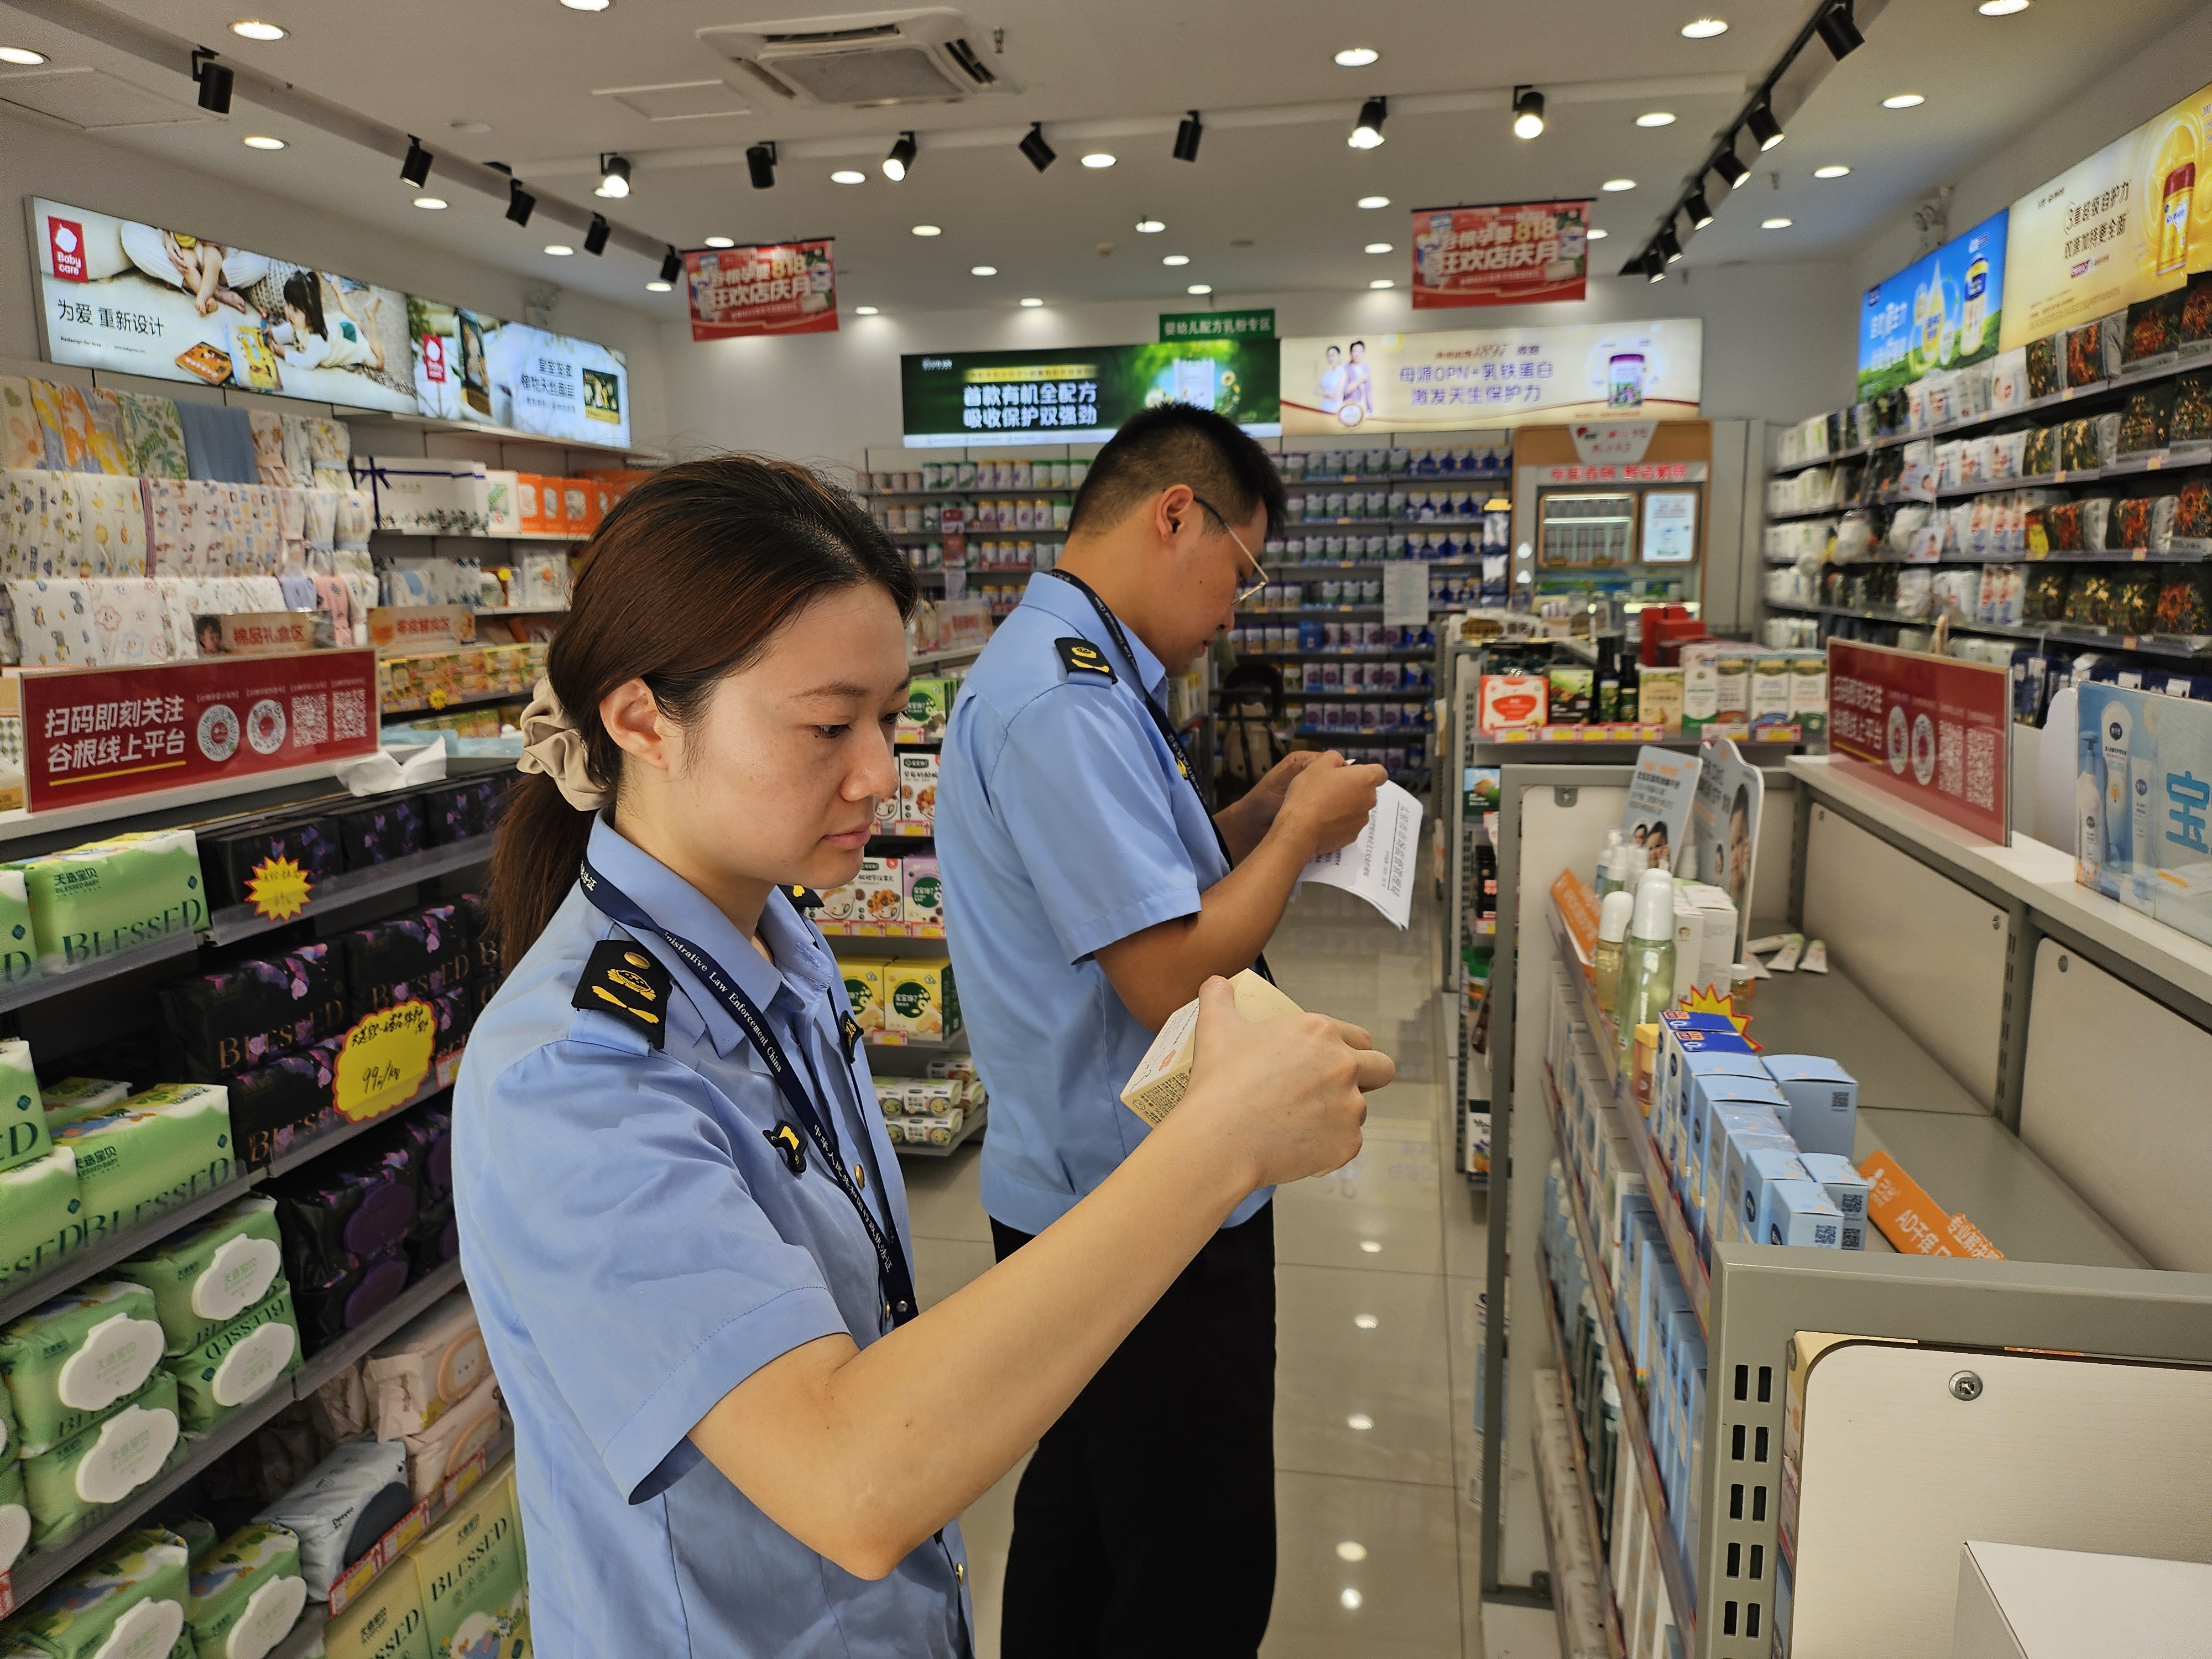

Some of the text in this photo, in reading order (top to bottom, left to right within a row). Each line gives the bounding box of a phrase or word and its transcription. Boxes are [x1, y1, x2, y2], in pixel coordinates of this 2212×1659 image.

[1515, 217, 1557, 241] 818
[58, 252, 81, 269] Baby
[59, 263, 80, 276] care
[772, 255, 807, 278] 818
[1441, 242, 1559, 275] 狂欢店庆月
[713, 276, 811, 311] 狂欢店庆月
[58, 299, 164, 338] 为爱 重新设计
[1164, 317, 1271, 336] 婴幼儿配方乳粉专区
[1400, 360, 1554, 384] 母源OPN+乳铁蛋白
[964, 382, 1097, 406] 首款有机全配方
[1411, 384, 1541, 406] 激发天生保护力
[963, 404, 1097, 428] 吸收保护双强劲
[1551, 464, 1687, 482] 中国首创 鲜活奶粉
[45, 696, 185, 739] 扫码即刻关注
[47, 729, 186, 773] 谷根线上平台
[54, 867, 98, 886] 天选宝贝
[62, 899, 201, 965] BLESSED
[709, 971, 728, 994] Law
[728, 992, 769, 1047] Enforcement
[766, 1045, 782, 1073] China
[82, 1157, 229, 1248] BLESSED
[814, 1124, 893, 1273] 中华人民共和国行政执法证
[431, 1517, 507, 1601] BLESSED
